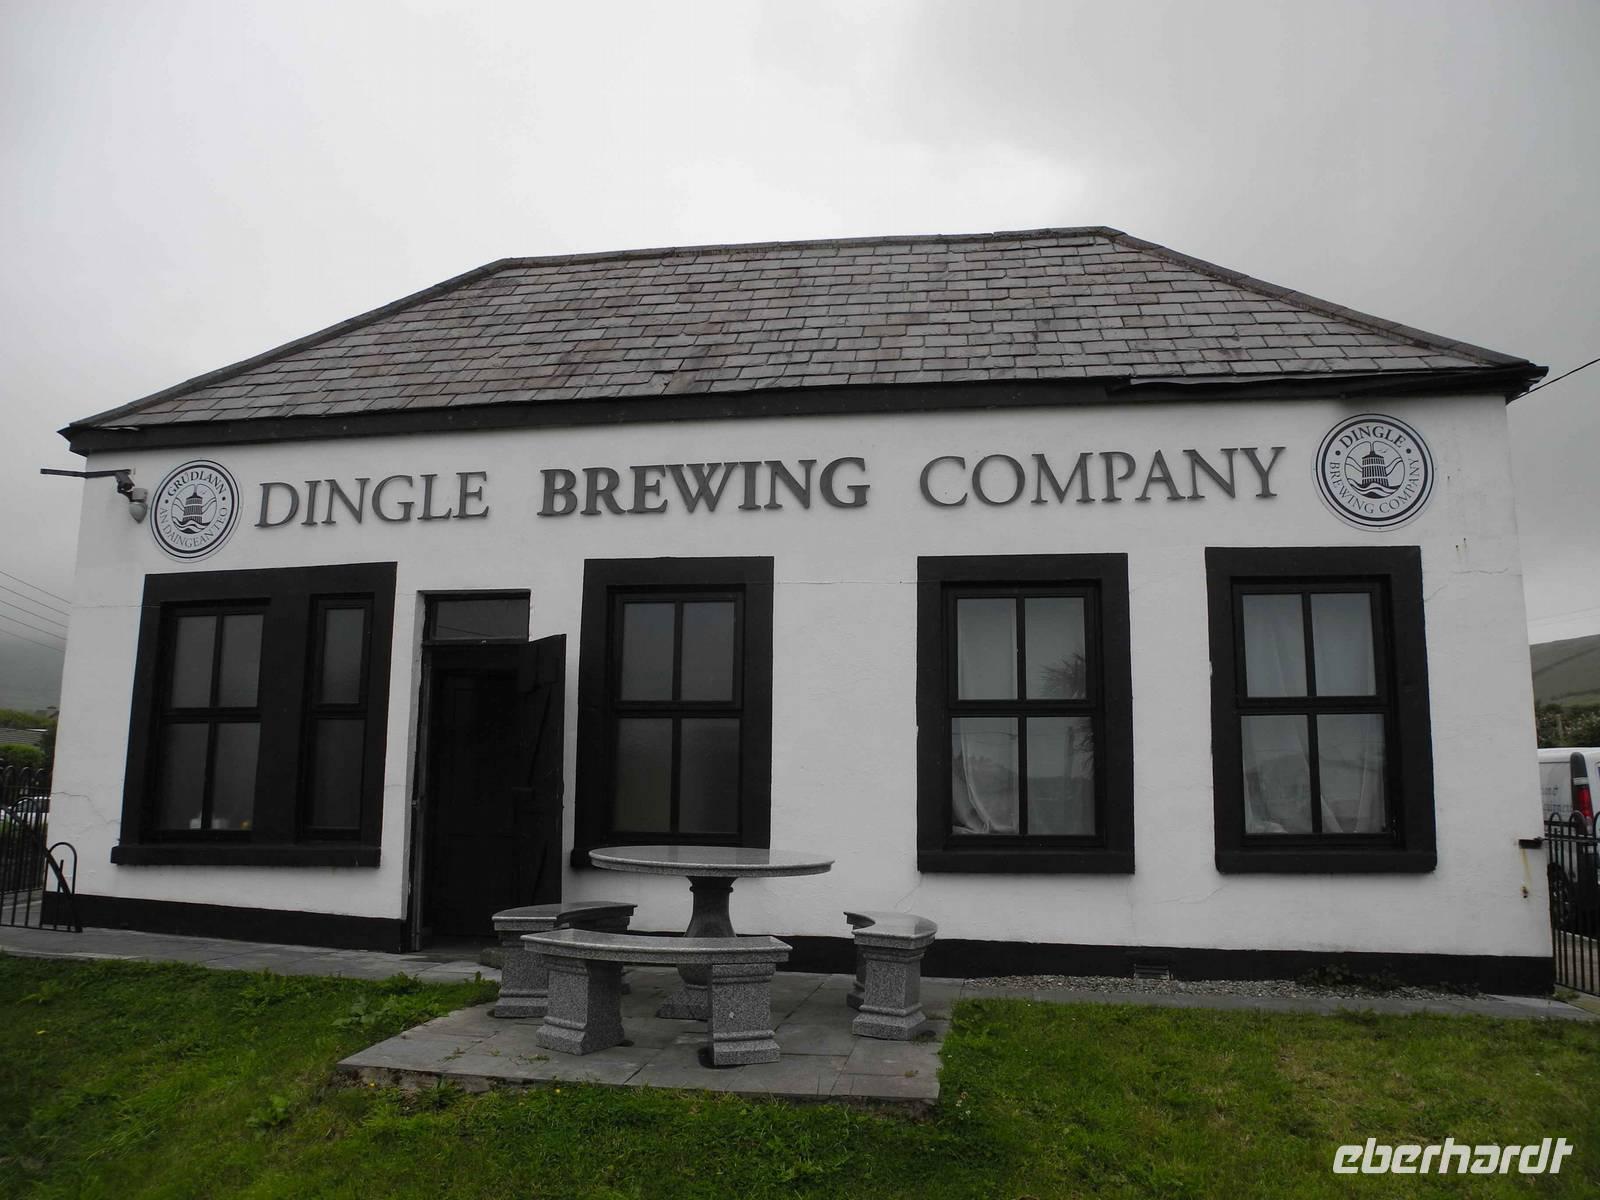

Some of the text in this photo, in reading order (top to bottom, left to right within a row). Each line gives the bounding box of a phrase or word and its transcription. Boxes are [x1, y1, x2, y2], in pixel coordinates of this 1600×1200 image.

[1340, 426, 1406, 448] DINGLE
[255, 446, 1287, 529] DINGLE BREWING COMPANY
[1329, 458, 1420, 514] BREWING COMPANY
[159, 508, 168, 524] AN
[163, 525, 213, 548] DAINGEAN
